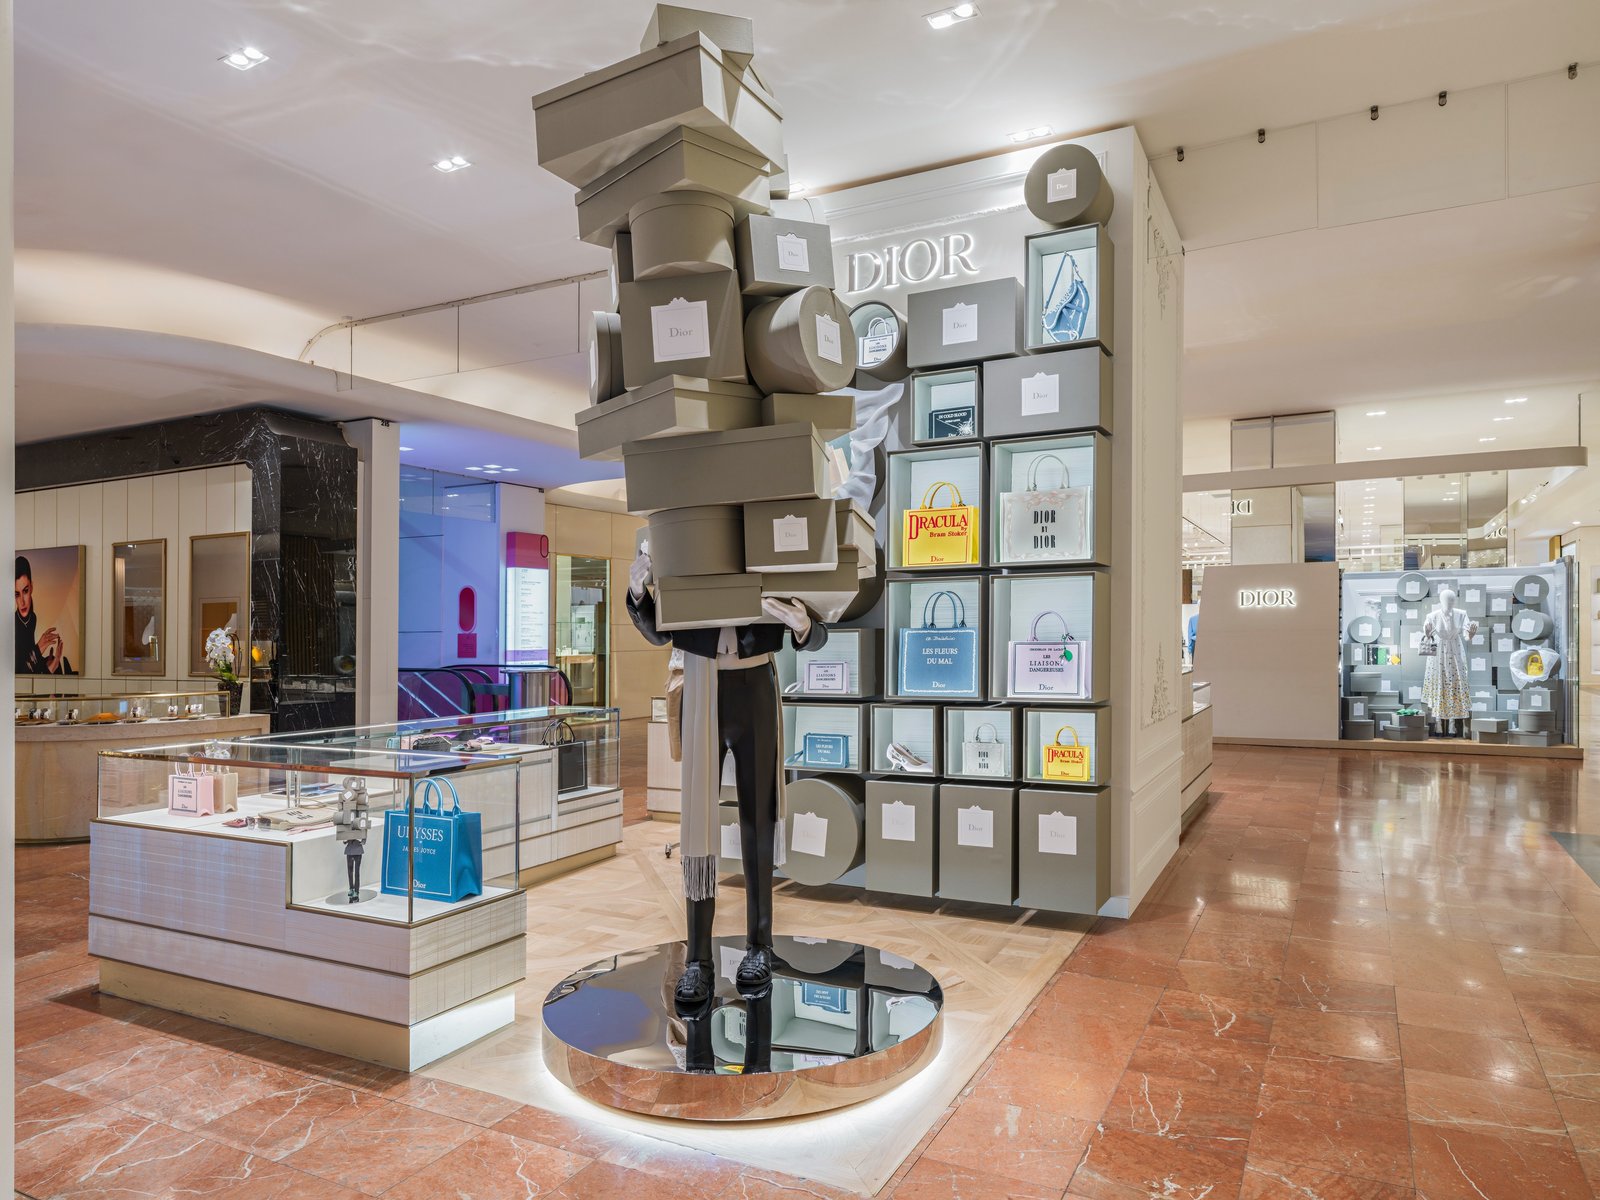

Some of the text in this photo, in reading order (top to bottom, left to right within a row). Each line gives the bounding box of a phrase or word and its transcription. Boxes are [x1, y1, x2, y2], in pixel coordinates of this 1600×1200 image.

[846, 233, 979, 293] DIOR
[669, 327, 693, 337] Dior
[1032, 392, 1048, 400] Dior
[1033, 509, 1056, 524] DIOR
[908, 514, 968, 540] DRACULA
[1041, 525, 1048, 533] BY
[1033, 534, 1056, 549] DIOR
[1240, 590, 1296, 606] DIOR
[922, 647, 958, 655] LES FLEURS
[926, 657, 953, 665] DU MAL
[1039, 683, 1054, 691] Dior
[1047, 748, 1084, 763] DRACULA
[968, 823, 983, 831] Dior
[402, 845, 436, 855] JAES JOYCE
[413, 879, 427, 889] Dior
